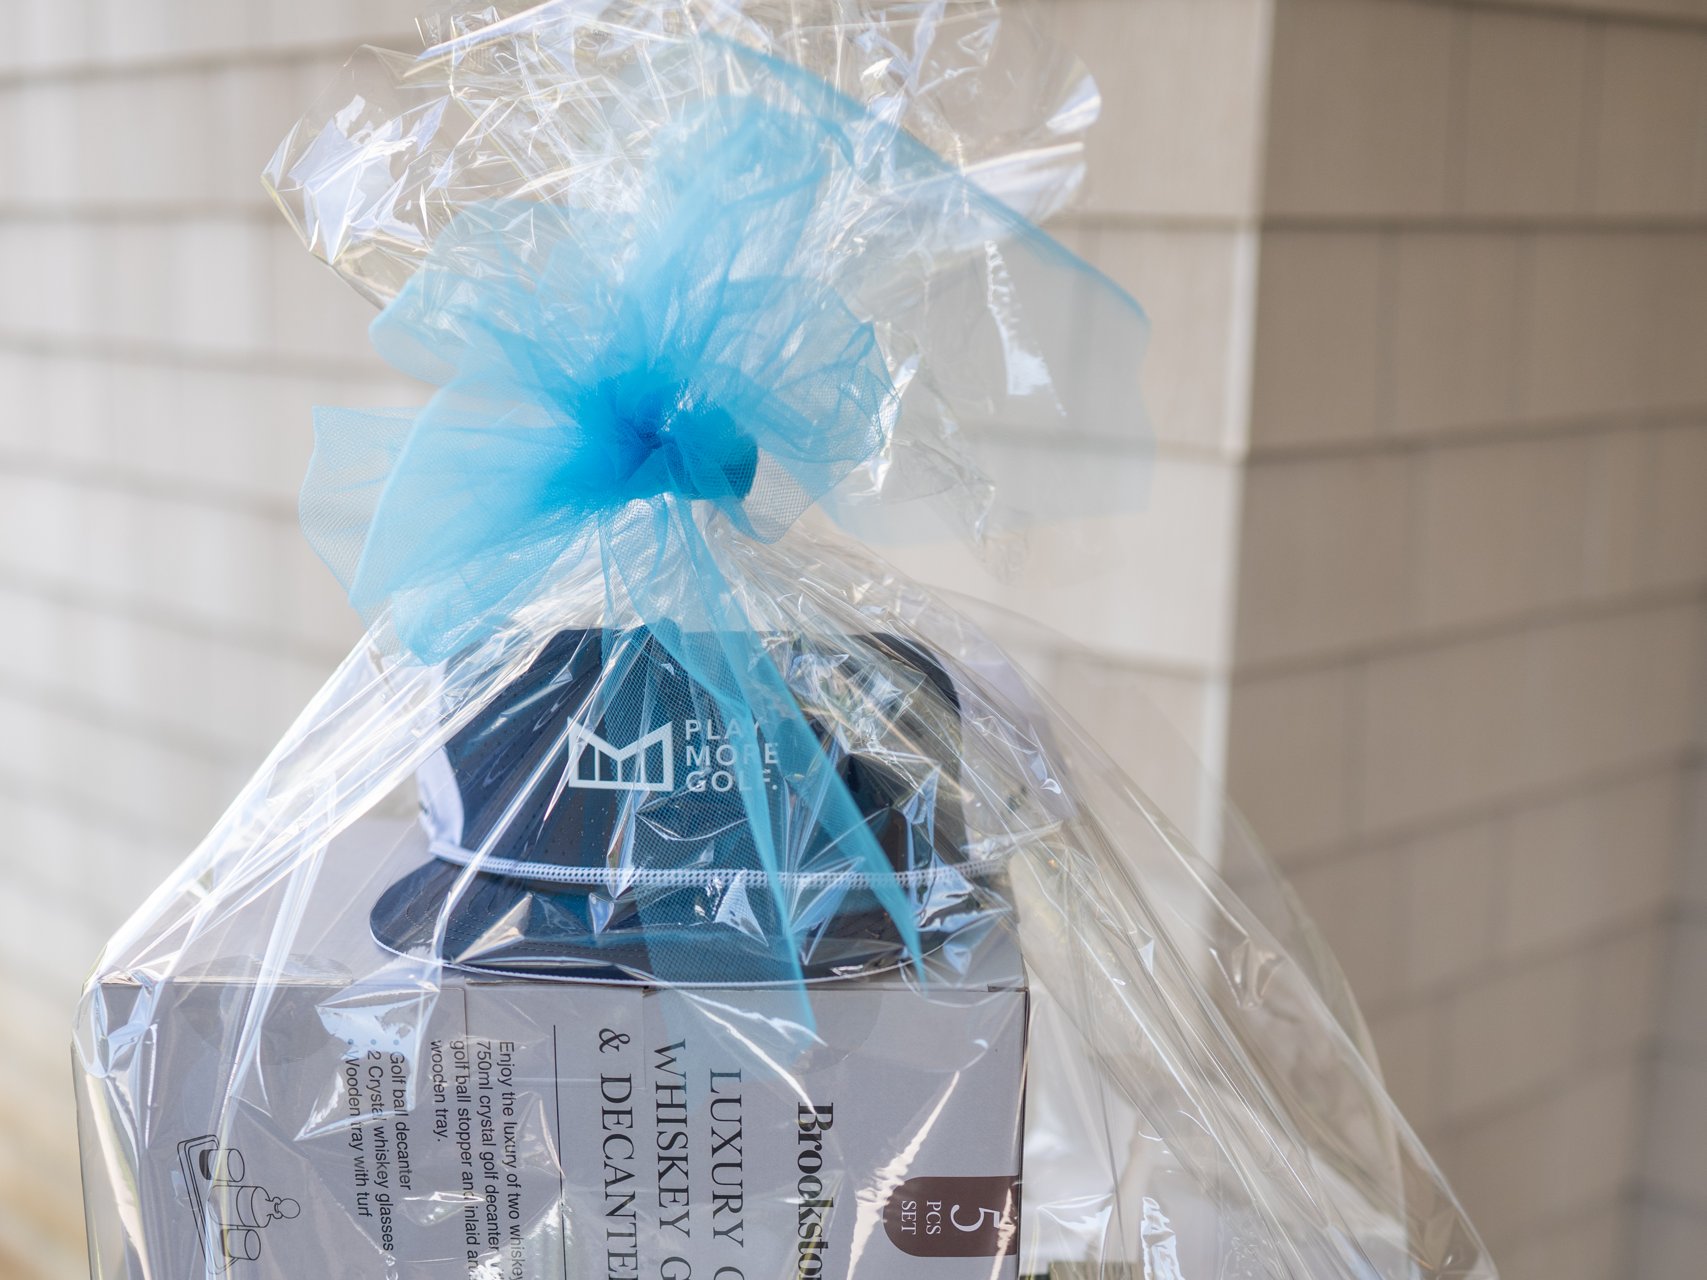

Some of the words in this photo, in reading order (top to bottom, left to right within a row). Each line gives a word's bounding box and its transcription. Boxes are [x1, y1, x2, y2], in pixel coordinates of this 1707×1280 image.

[367, 1050, 380, 1060] 2
[450, 1040, 469, 1069] golf
[599, 1028, 630, 1054] &
[390, 1052, 406, 1083] Golf
[431, 1040, 447, 1102] wooden
[477, 1040, 493, 1089] 750ml
[497, 1042, 514, 1086] Enjoy
[344, 1051, 363, 1116] Wooden
[364, 1065, 387, 1121] Crystal
[456, 1075, 471, 1102] ball
[393, 1089, 408, 1116] ball
[502, 1092, 517, 1116] the
[348, 1121, 366, 1151] tray
[433, 1108, 449, 1142] tray.
[456, 1108, 474, 1167] stopper
[477, 1095, 496, 1146] crystal
[395, 1121, 412, 1190] decanter
[502, 1122, 518, 1167] luxury
[654, 1040, 690, 1238] WHISKEY
[353, 1156, 370, 1187] with
[372, 1126, 393, 1188] whiskey
[479, 1151, 499, 1180] golf
[709, 1068, 745, 1248] LUXURY
[462, 1171, 476, 1200] and
[507, 1173, 521, 1189] of
[357, 1192, 373, 1217] turf
[376, 1193, 397, 1251] glasses
[485, 1185, 500, 1251] decanter
[508, 1193, 521, 1219] two
[899, 1200, 917, 1235] SET
[924, 1200, 943, 1235] PCS
[950, 1204, 1001, 1233] 5
[464, 1205, 479, 1244] inlaid
